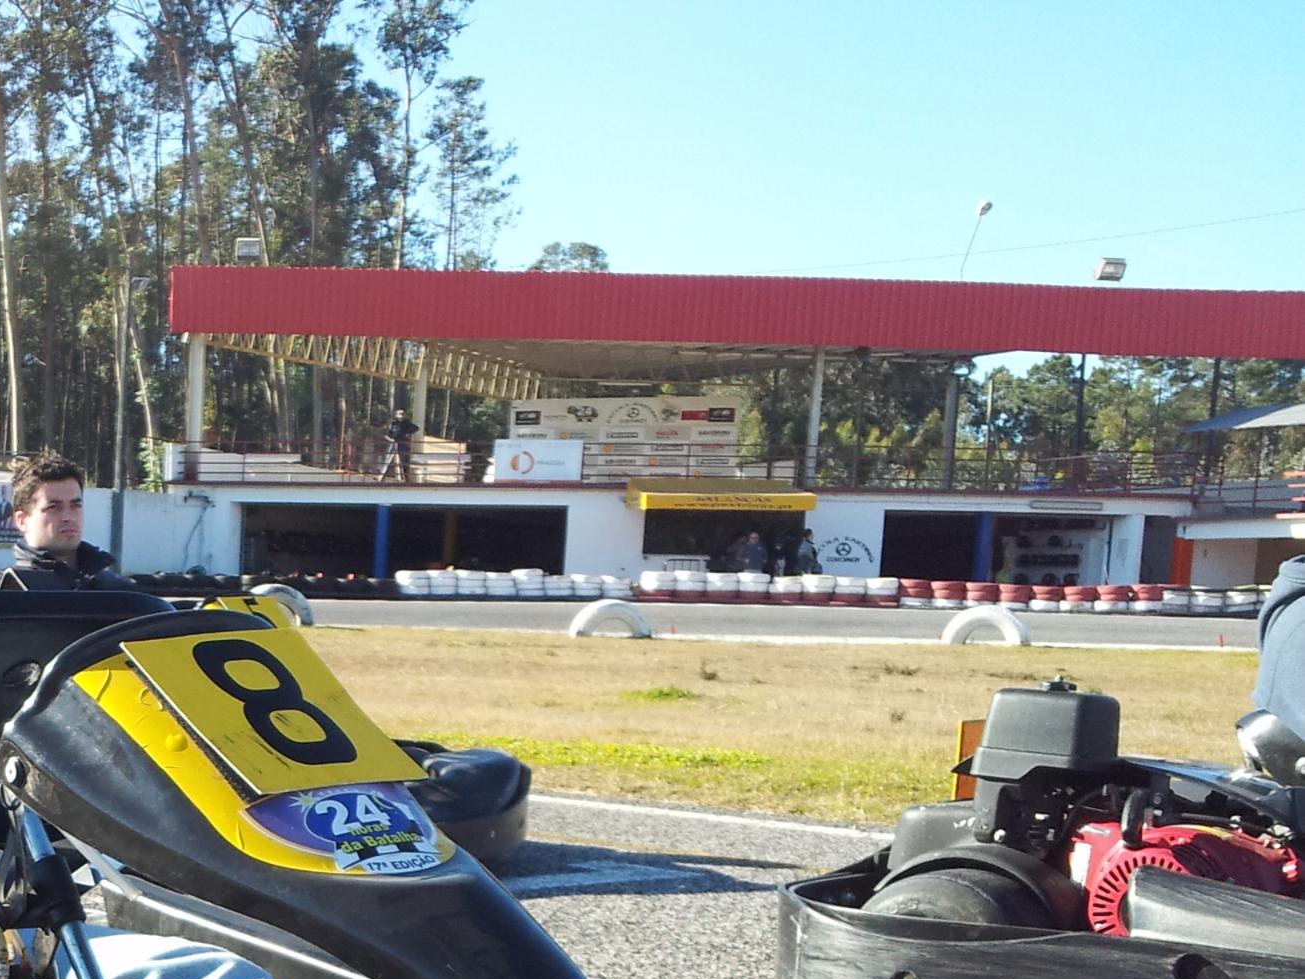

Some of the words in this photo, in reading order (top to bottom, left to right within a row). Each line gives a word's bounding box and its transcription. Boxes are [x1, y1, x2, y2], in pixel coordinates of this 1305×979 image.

[193, 639, 357, 765] 8
[315, 795, 392, 836] 24
[349, 822, 390, 836] horas
[341, 840, 363, 854] da
[363, 831, 422, 847] Batalha
[394, 853, 437, 870] EDIÇÃO
